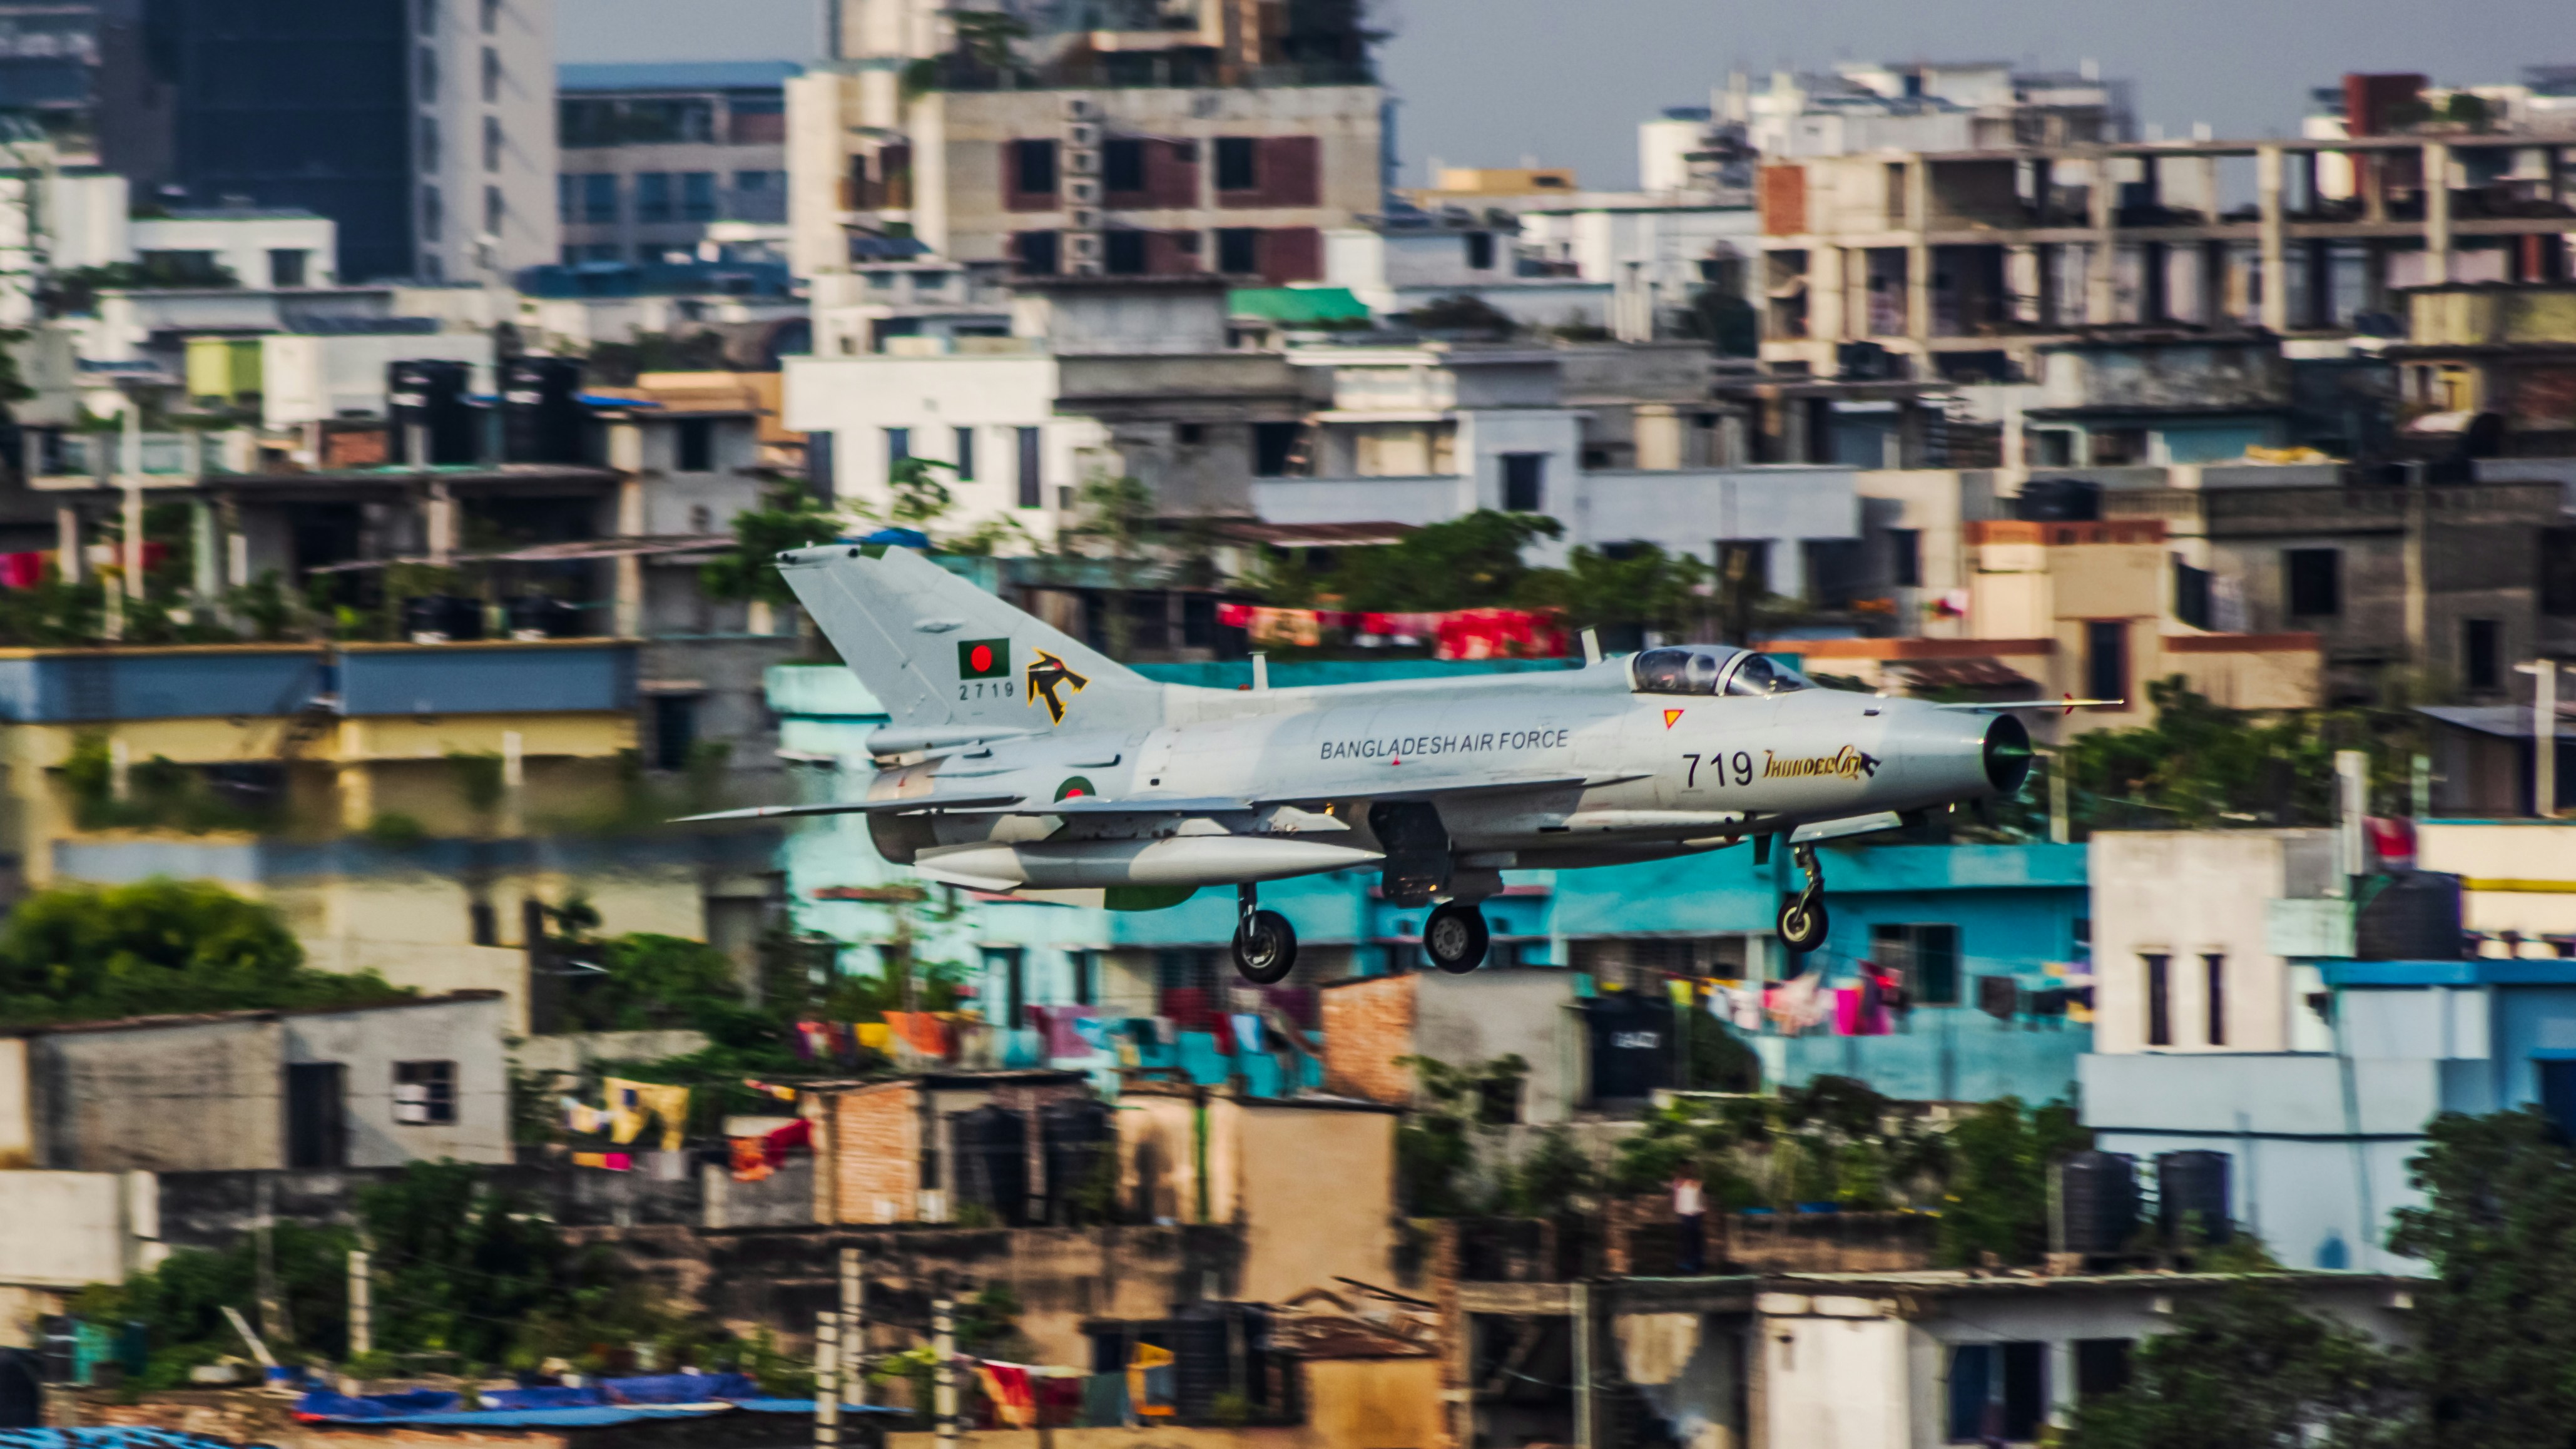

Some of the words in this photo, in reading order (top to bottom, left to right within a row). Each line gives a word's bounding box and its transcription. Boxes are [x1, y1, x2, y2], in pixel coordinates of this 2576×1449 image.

[959, 681, 1014, 701] 2719
[1320, 736, 1457, 760] BANGLADESH
[1460, 733, 1494, 753] AIR
[1499, 729, 1569, 750] FORCE
[1683, 751, 1752, 788] 719
